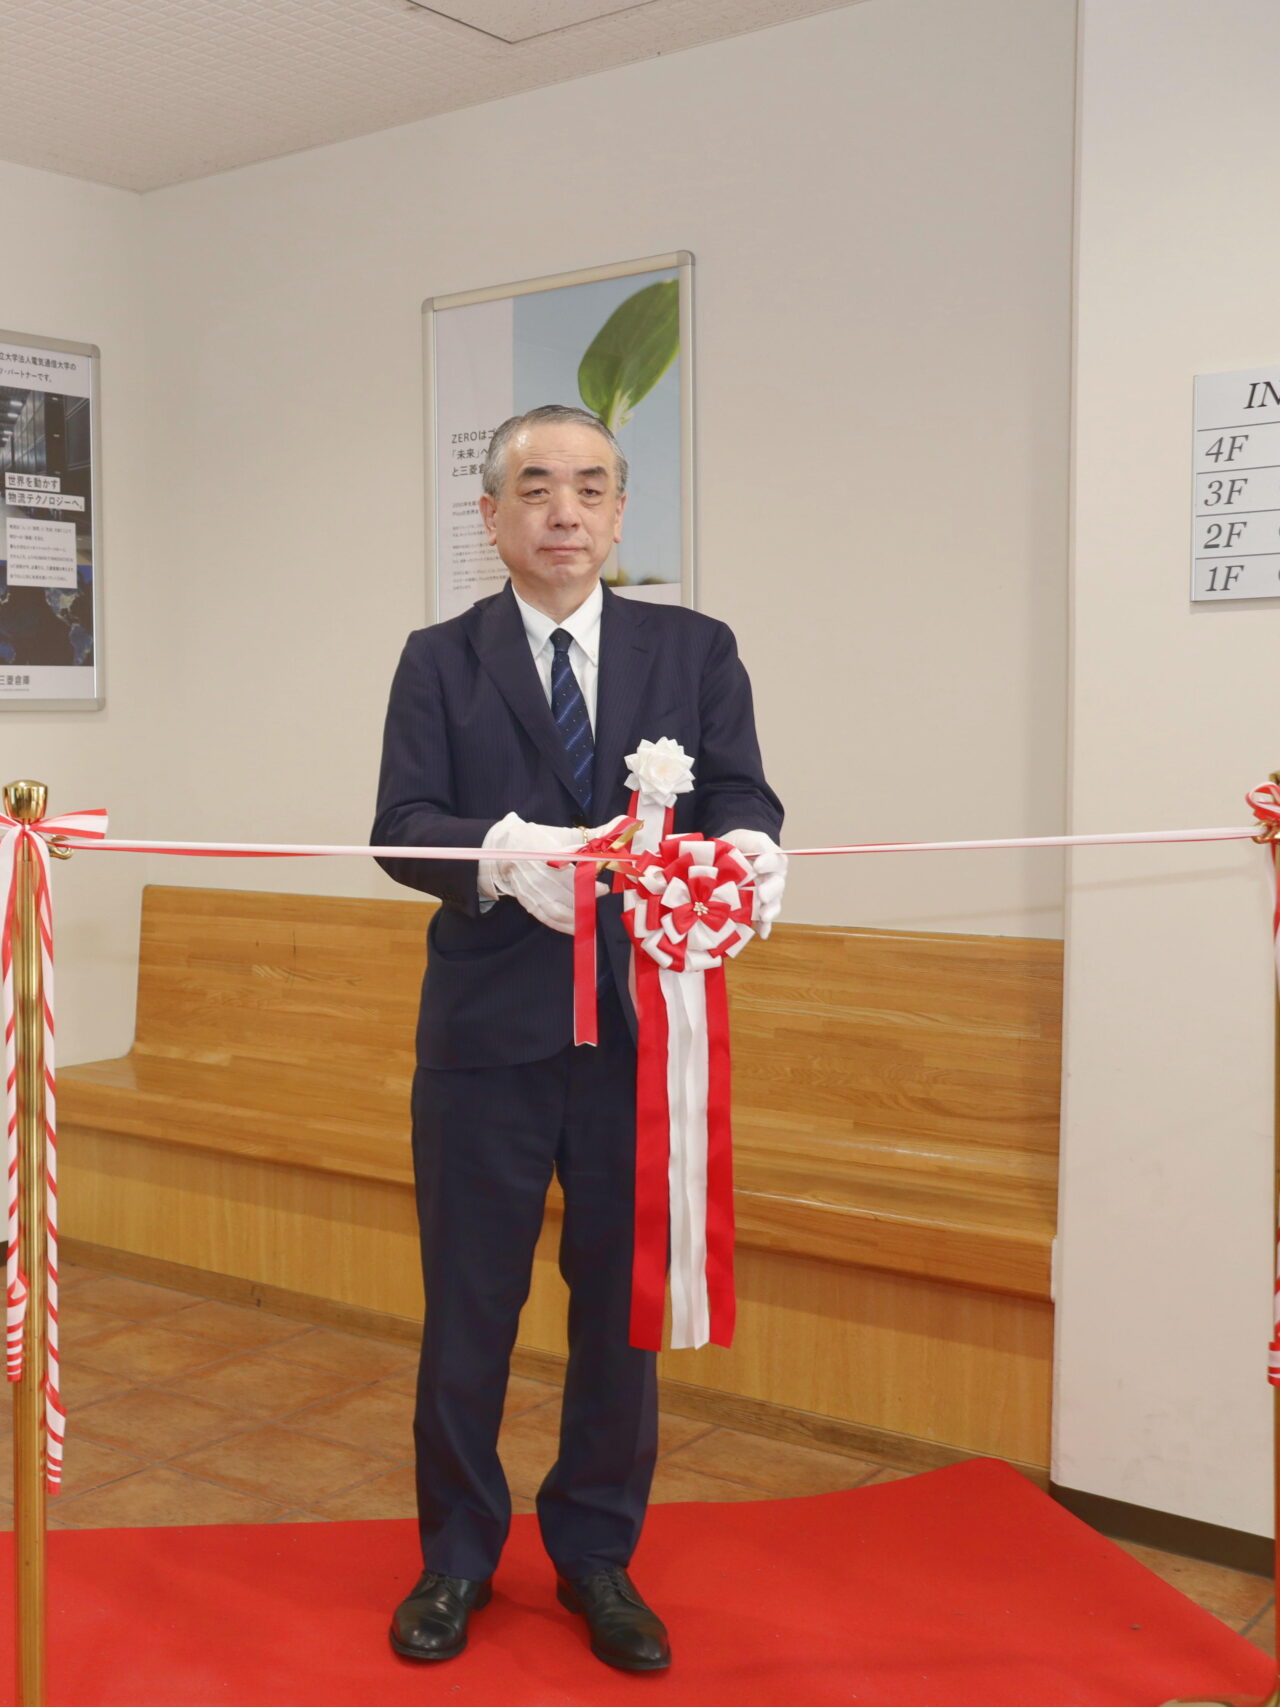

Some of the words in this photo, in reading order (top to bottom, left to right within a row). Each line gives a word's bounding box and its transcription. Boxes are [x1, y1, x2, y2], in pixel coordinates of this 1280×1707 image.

[1205, 435, 1249, 463] 4F
[8, 475, 58, 489] 世界を動かす
[1204, 478, 1248, 507] 3F
[1203, 521, 1247, 549] 2F
[1205, 565, 1244, 592] 1F
